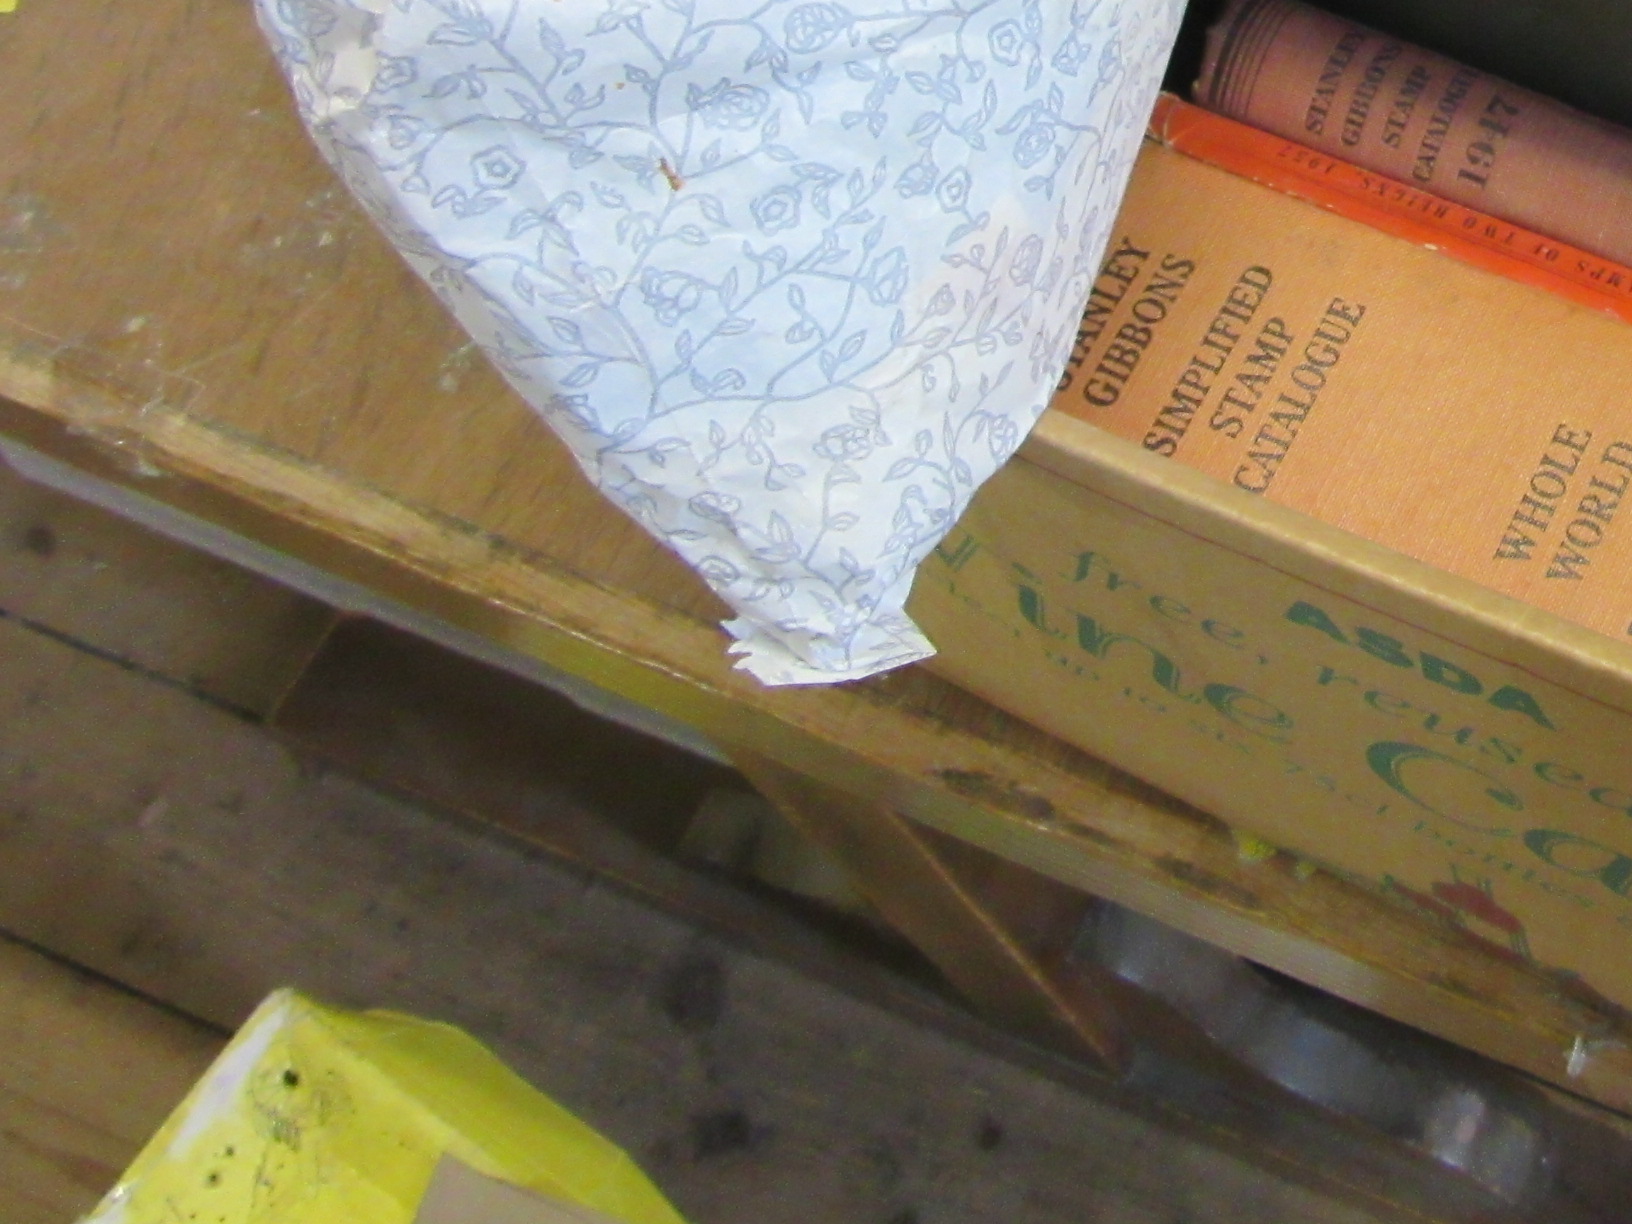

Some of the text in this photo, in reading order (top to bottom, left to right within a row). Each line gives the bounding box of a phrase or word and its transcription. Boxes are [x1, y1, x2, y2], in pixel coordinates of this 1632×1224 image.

[1305, 30, 1365, 138] STANLEY
[1340, 38, 1402, 148] GIBBONS
[1381, 63, 1430, 150] STAMP
[1456, 94, 1522, 191] 1947
[1461, 215, 1516, 245] TWO
[1533, 241, 1562, 263] OF
[1082, 253, 1195, 407] GIBBONS
[1143, 265, 1273, 458] SIMPLIFIED
[1209, 316, 1294, 439] STAMP
[1233, 296, 1366, 494] CATALOGUE
[1493, 424, 1592, 560] WHOLE
[1055, 550, 1269, 666] free,
[1285, 599, 1556, 731] ASDA
